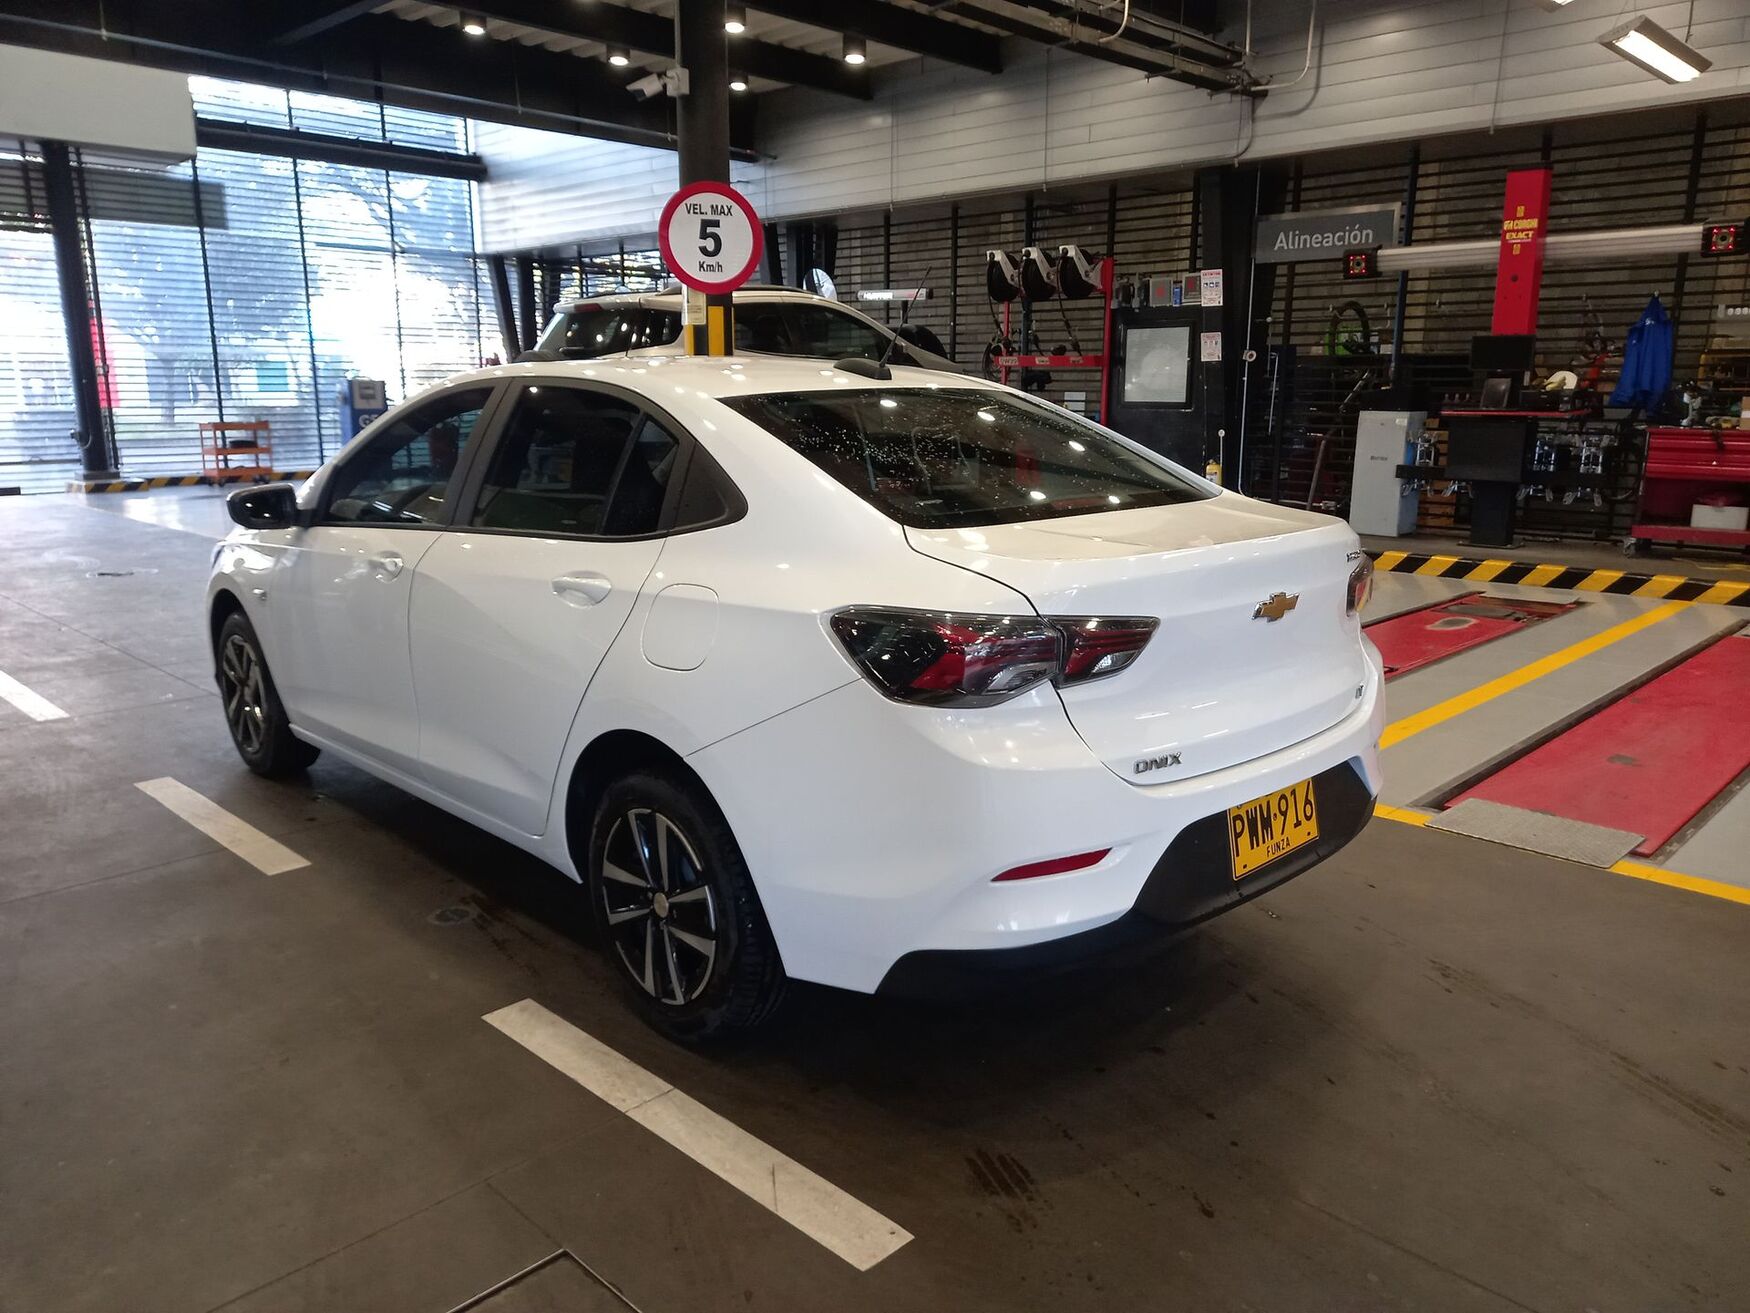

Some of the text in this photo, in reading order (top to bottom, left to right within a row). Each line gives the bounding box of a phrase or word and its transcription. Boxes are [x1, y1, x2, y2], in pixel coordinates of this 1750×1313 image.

[684, 202, 734, 217] VEL. MAX
[698, 218, 723, 258] 5
[1273, 223, 1374, 251] Alineación
[698, 260, 724, 273] Km/h
[1133, 751, 1182, 775] ONIX
[1265, 836, 1291, 858] FUNZA
